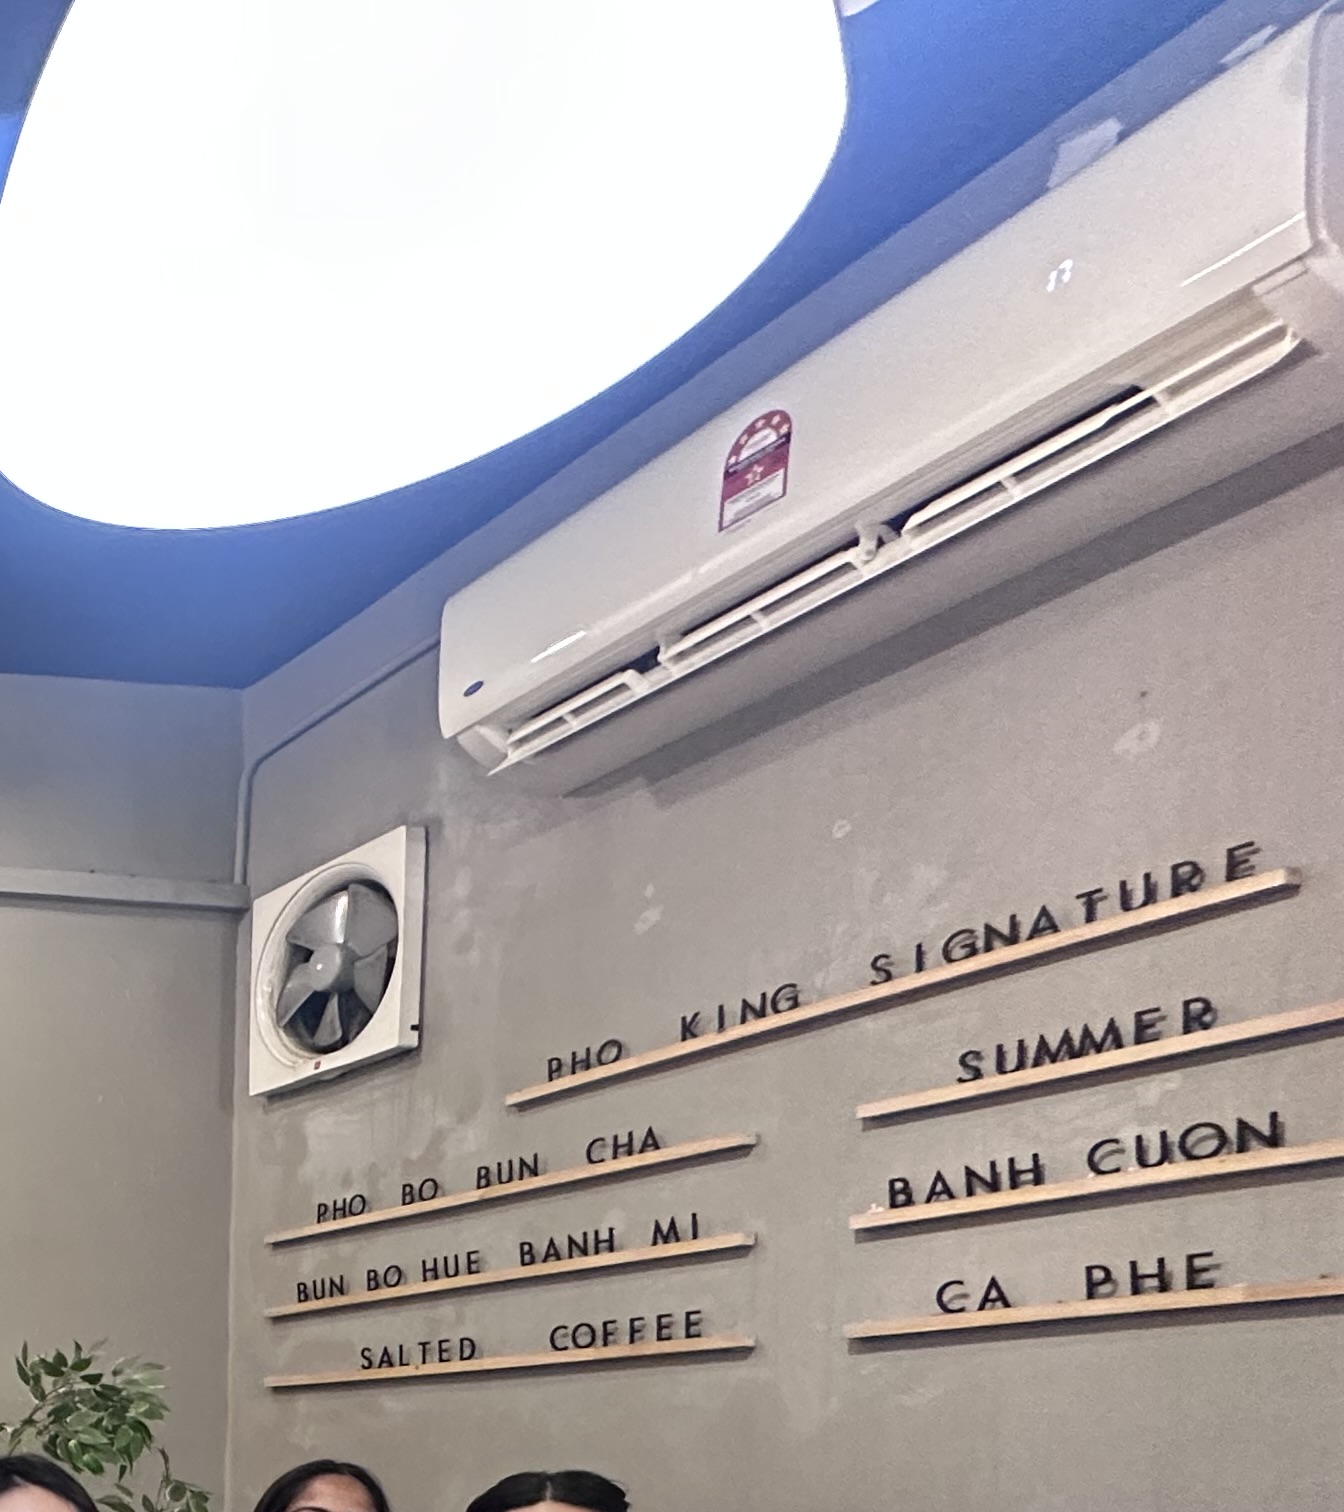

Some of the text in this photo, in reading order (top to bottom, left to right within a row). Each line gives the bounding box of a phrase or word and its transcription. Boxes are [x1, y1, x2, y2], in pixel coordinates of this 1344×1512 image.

[546, 840, 1256, 1083] PHO KING SIGNATURE
[956, 996, 1215, 1084] SUMMER
[316, 1125, 662, 1225] PHO BO BUN CHA
[887, 1110, 1281, 1209] BANH CUON
[296, 1212, 699, 1304] BUN BO HUE BANH MI
[935, 1250, 1215, 1314] CA PHE
[360, 1309, 702, 1370] SALTED COFFEE
